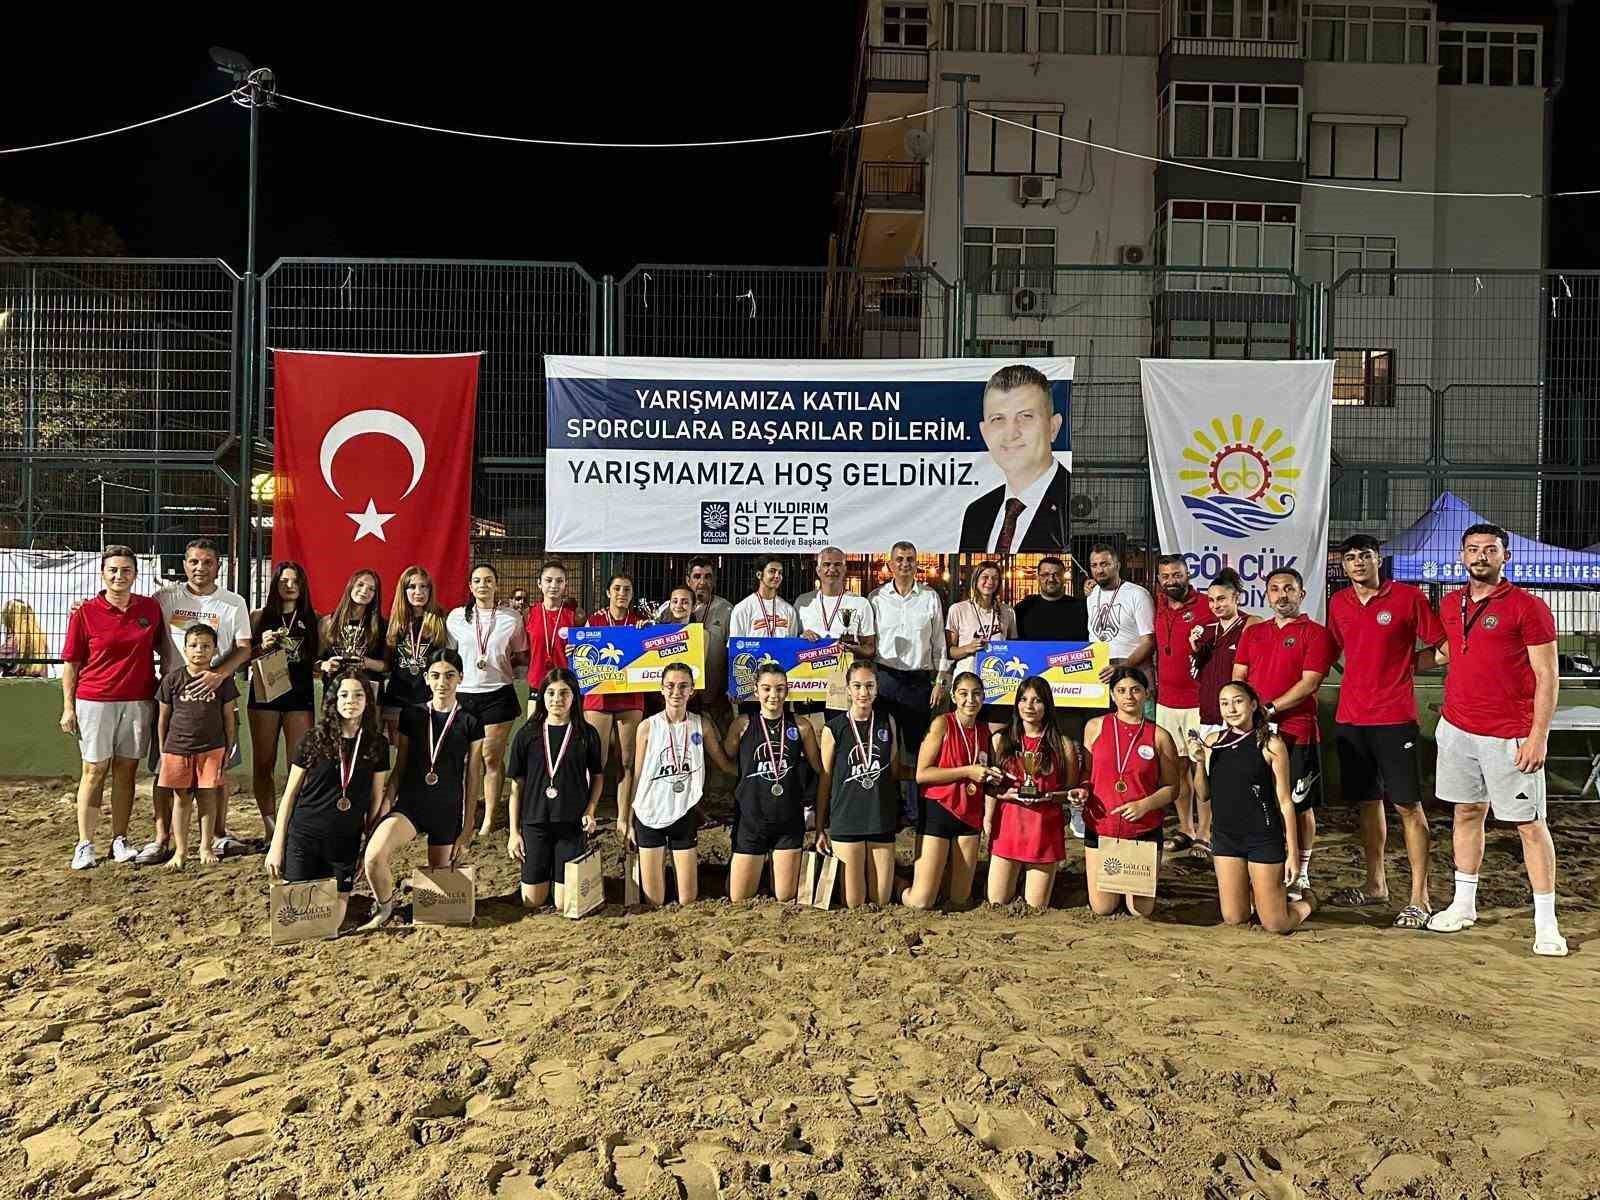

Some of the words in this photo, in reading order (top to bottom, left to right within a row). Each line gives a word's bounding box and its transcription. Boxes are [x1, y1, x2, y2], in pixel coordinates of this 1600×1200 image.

[636, 389, 797, 412] YARIŞMAMIZA
[803, 390, 901, 411] KATILAN
[566, 418, 724, 441] SPORCULARA
[731, 420, 864, 444] BAŞARILAR
[871, 418, 971, 442] DİLERİM.
[568, 460, 765, 490] YARIŞMAMIZA
[775, 463, 833, 491] HOŞ
[842, 457, 980, 487] GELDİNİZ.
[735, 499, 758, 514] ALİ
[763, 501, 828, 514] YILDIRIM
[734, 515, 829, 536] SEZER
[735, 536, 761, 545] Gölcük
[763, 537, 796, 547] Belediye
[798, 537, 829, 547] Başkanı
[641, 669, 664, 681] ÜÇÜ
